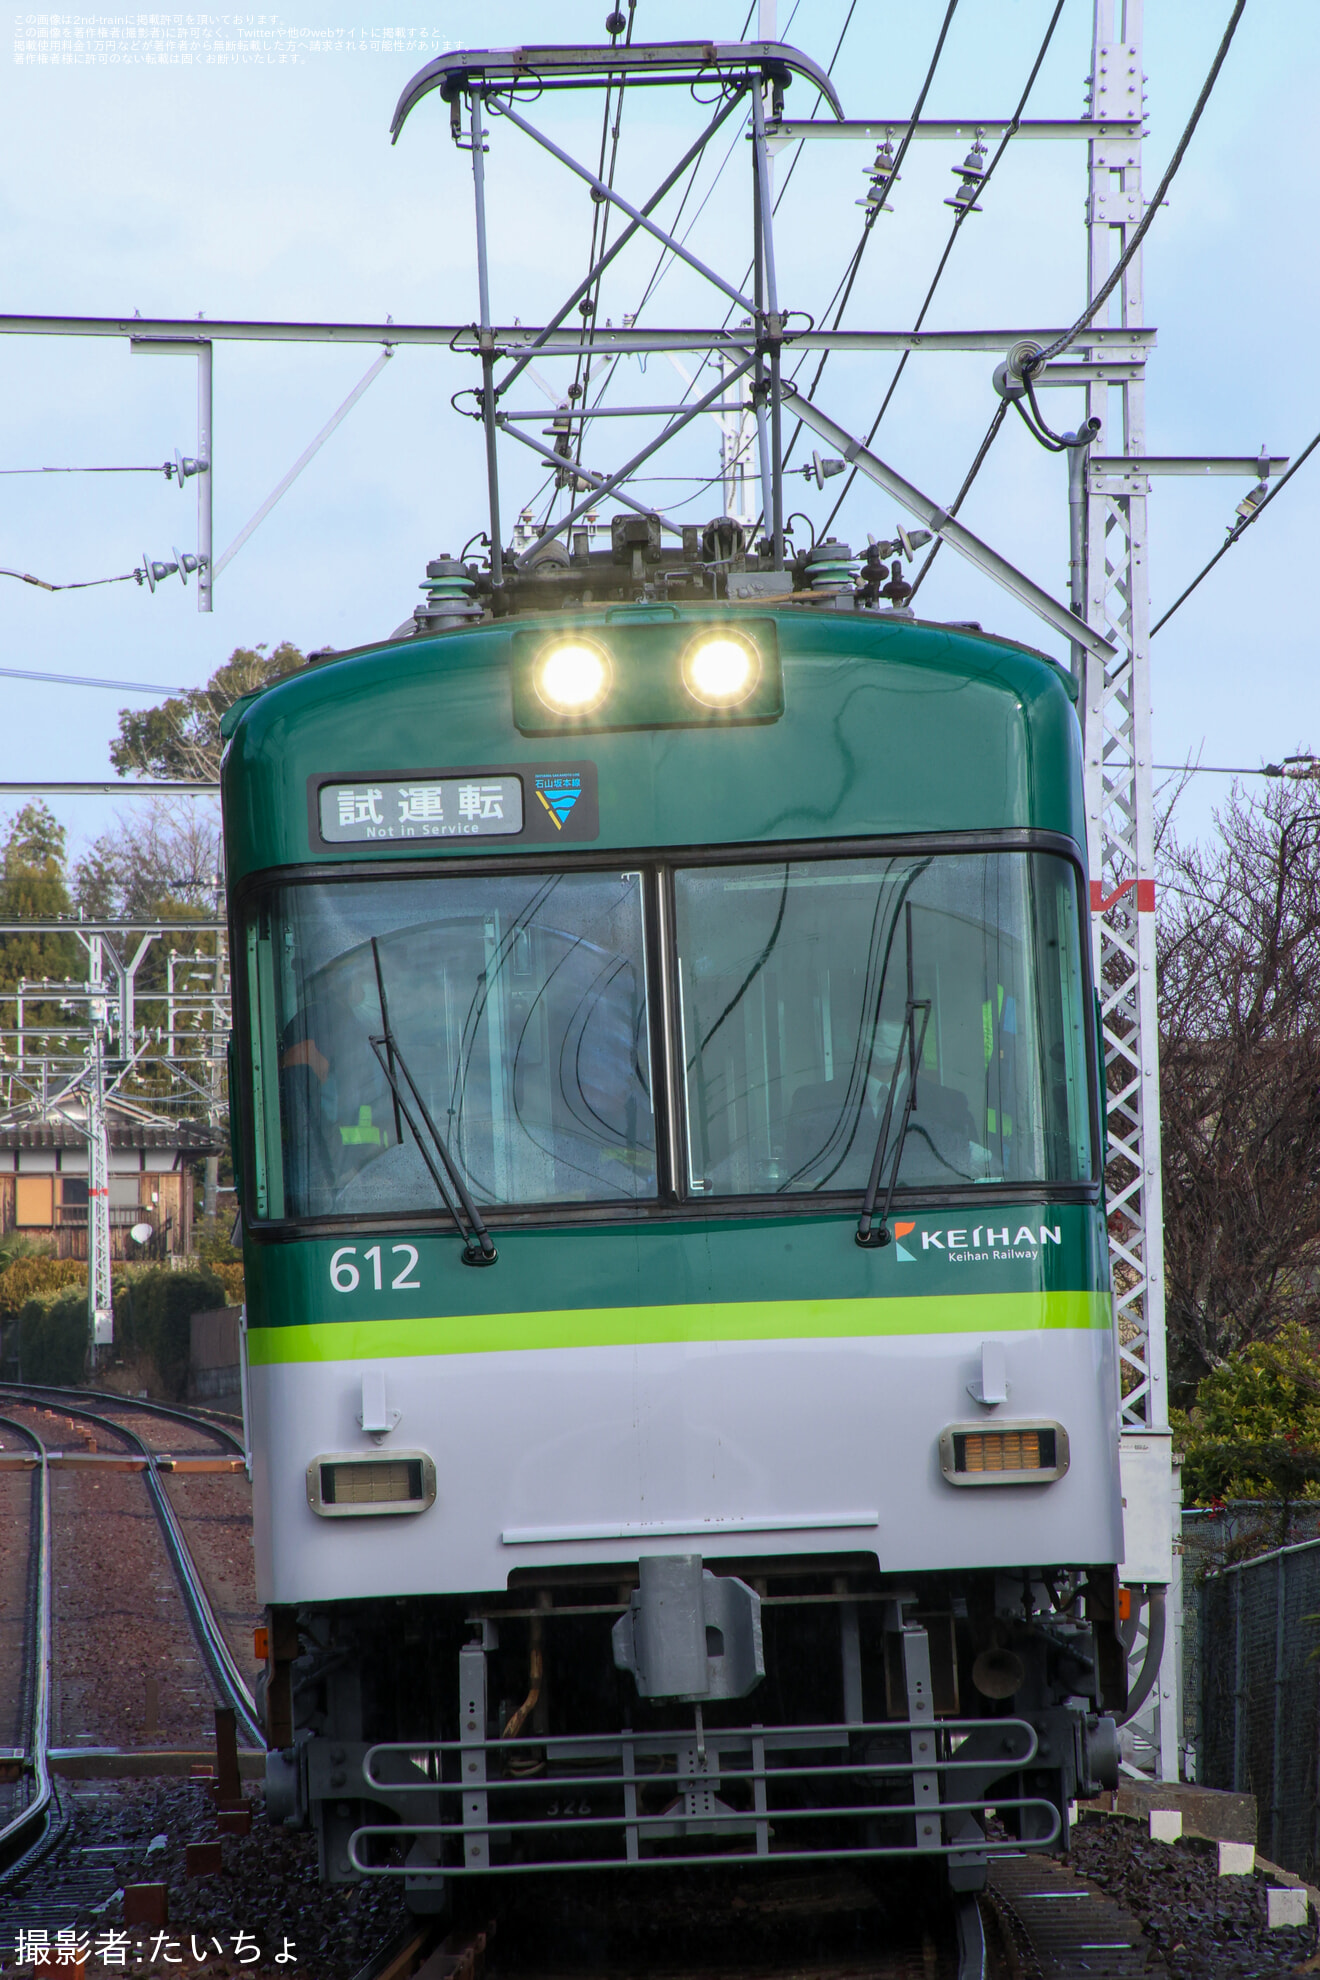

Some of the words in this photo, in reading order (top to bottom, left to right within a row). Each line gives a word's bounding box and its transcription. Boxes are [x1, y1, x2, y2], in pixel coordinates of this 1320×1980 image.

[535, 778, 581, 789] 石山坂本線
[336, 785, 504, 827] 試運転
[366, 826, 394, 838] Not
[401, 825, 415, 837] in
[422, 823, 480, 836] Service
[921, 1225, 1062, 1250] KEIHAN
[948, 1251, 989, 1263] Keihan
[992, 1249, 1039, 1261] Railway
[329, 1244, 421, 1293] 612
